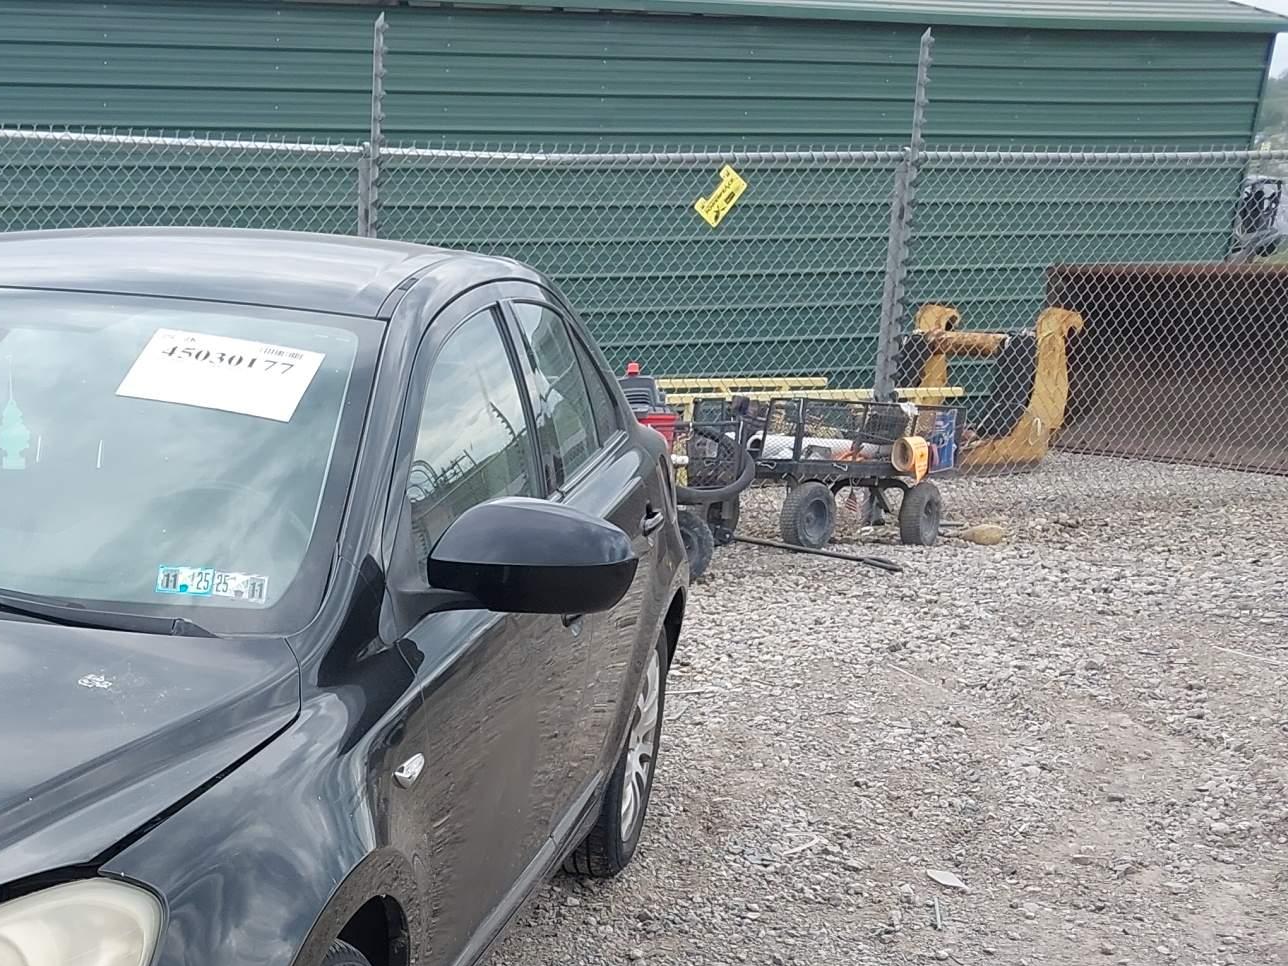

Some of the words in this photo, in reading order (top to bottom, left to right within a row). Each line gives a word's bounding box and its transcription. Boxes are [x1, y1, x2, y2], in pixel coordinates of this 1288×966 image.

[161, 345, 295, 375] 45030177
[196, 571, 210, 591] 25
[215, 574, 229, 593] 25
[250, 581, 264, 599] 11
